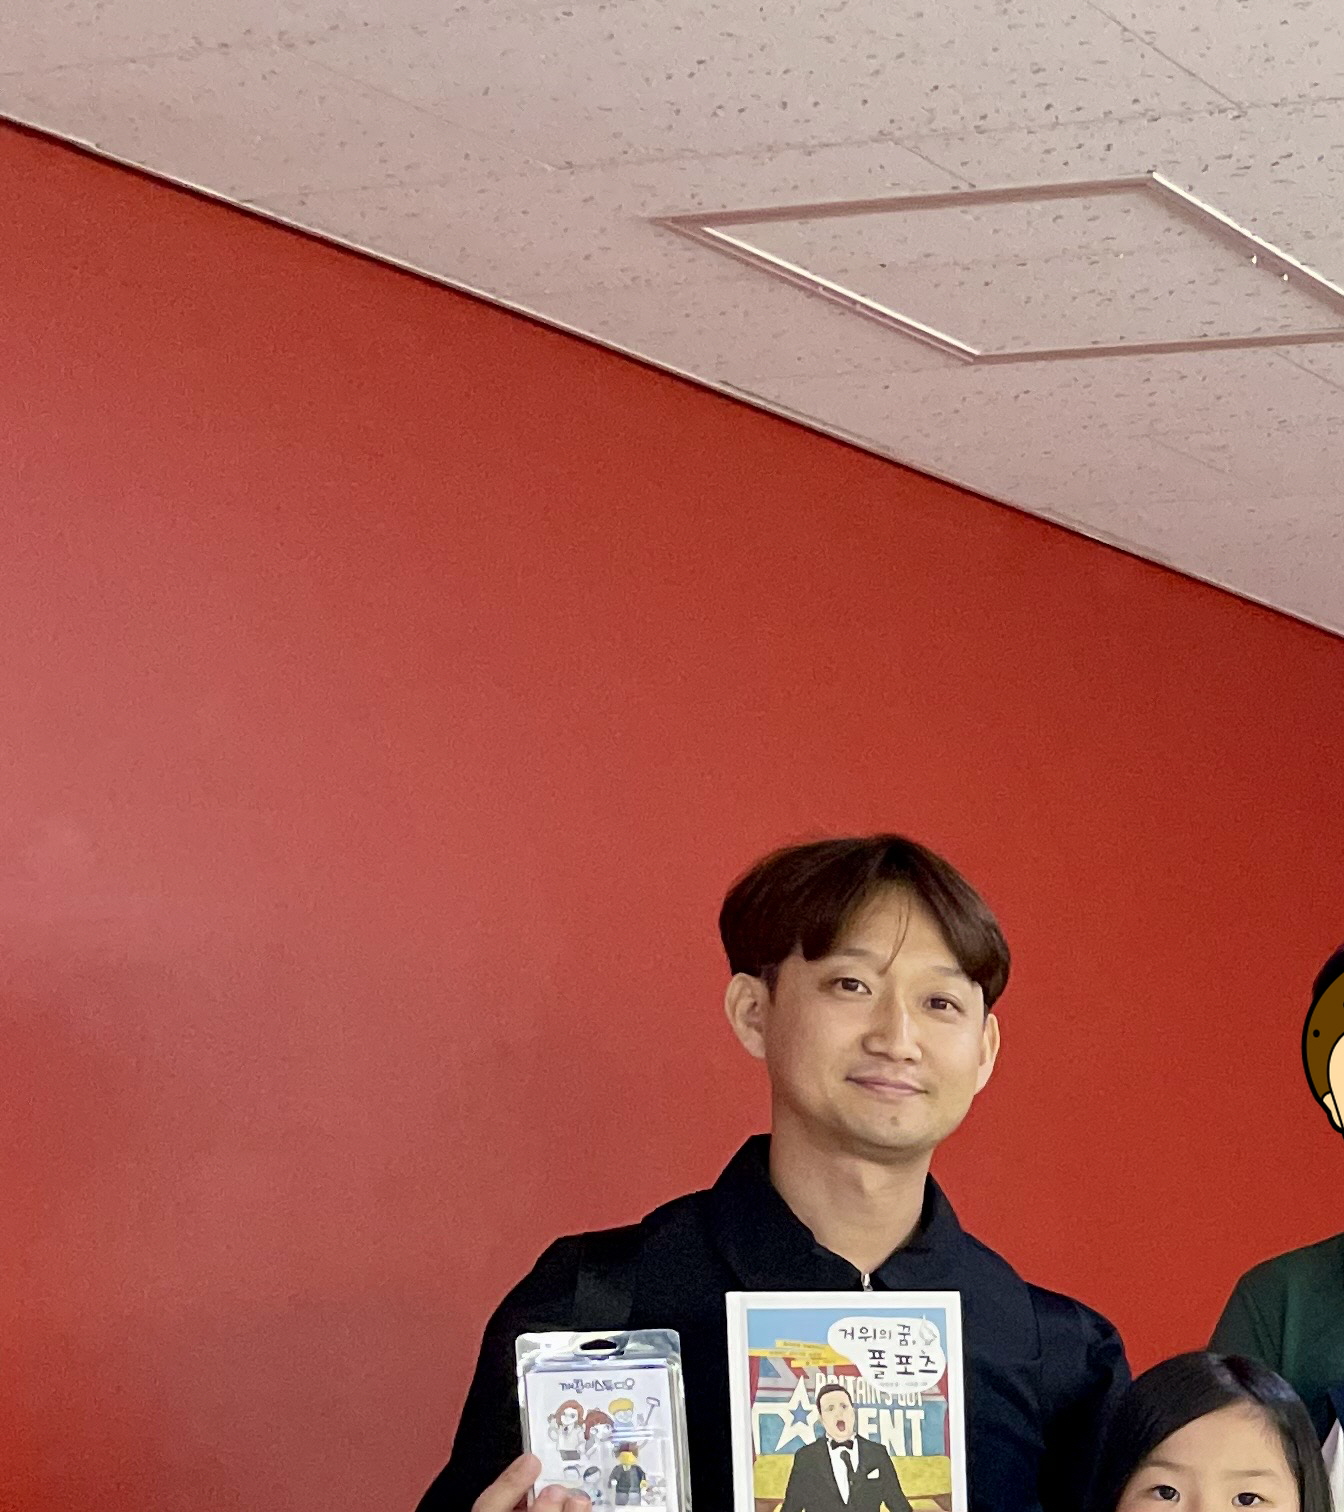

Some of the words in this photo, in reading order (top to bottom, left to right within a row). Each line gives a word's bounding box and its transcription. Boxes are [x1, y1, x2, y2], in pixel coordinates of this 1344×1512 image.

[839, 1326, 892, 1342] 거위의
[868, 1349, 888, 1380] 폴
[895, 1350, 938, 1376] 포츠
